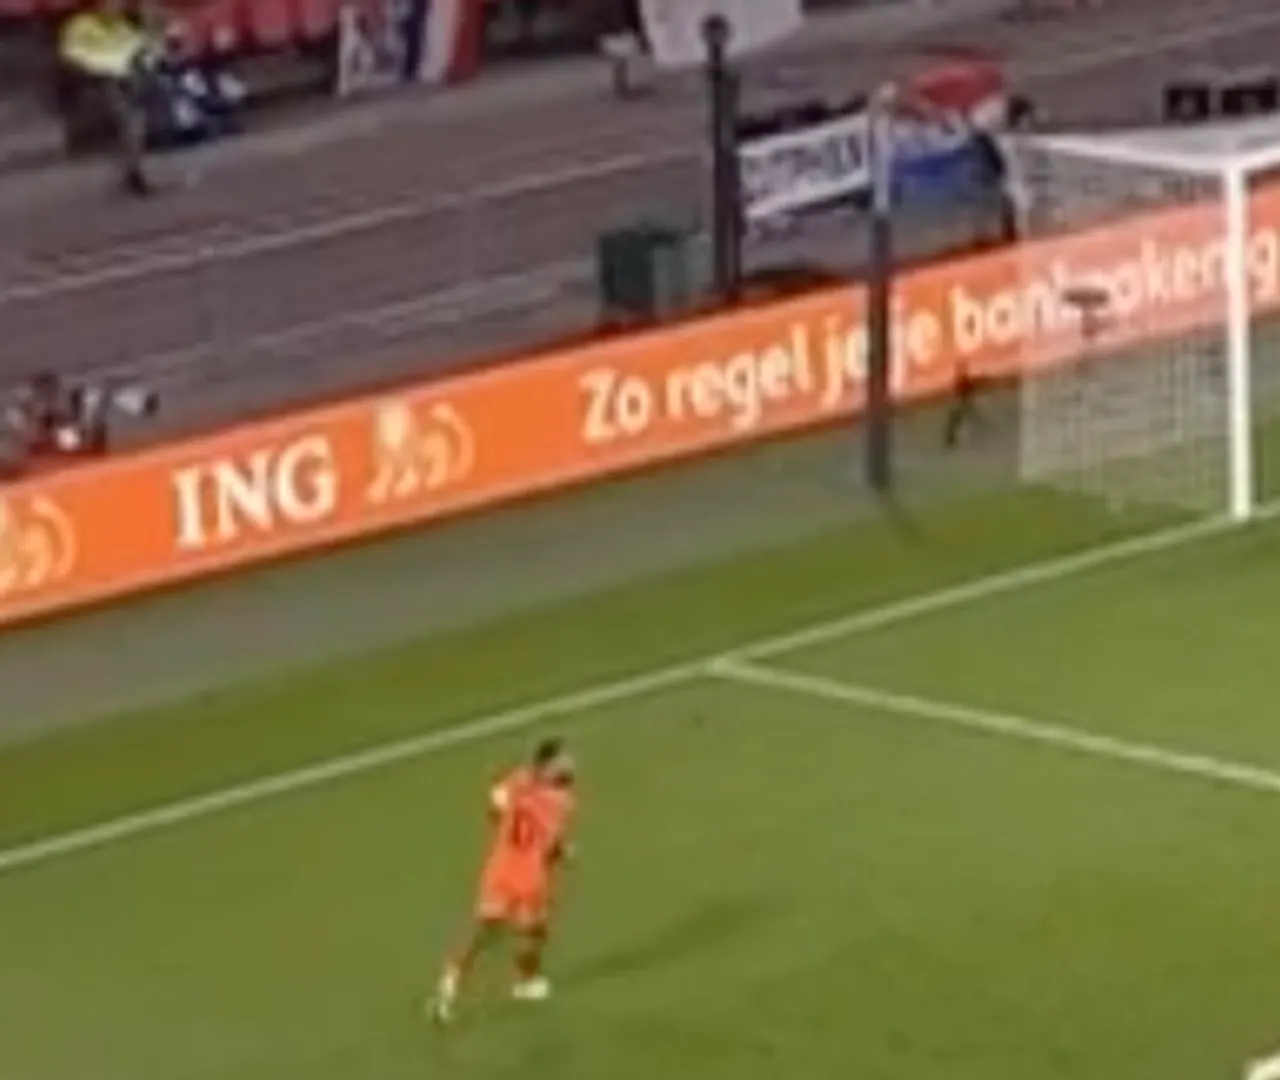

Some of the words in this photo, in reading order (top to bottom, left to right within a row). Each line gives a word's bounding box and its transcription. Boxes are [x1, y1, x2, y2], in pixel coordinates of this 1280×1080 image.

[578, 366, 653, 444] Zo
[665, 324, 815, 430] regel
[172, 434, 340, 551] ING
